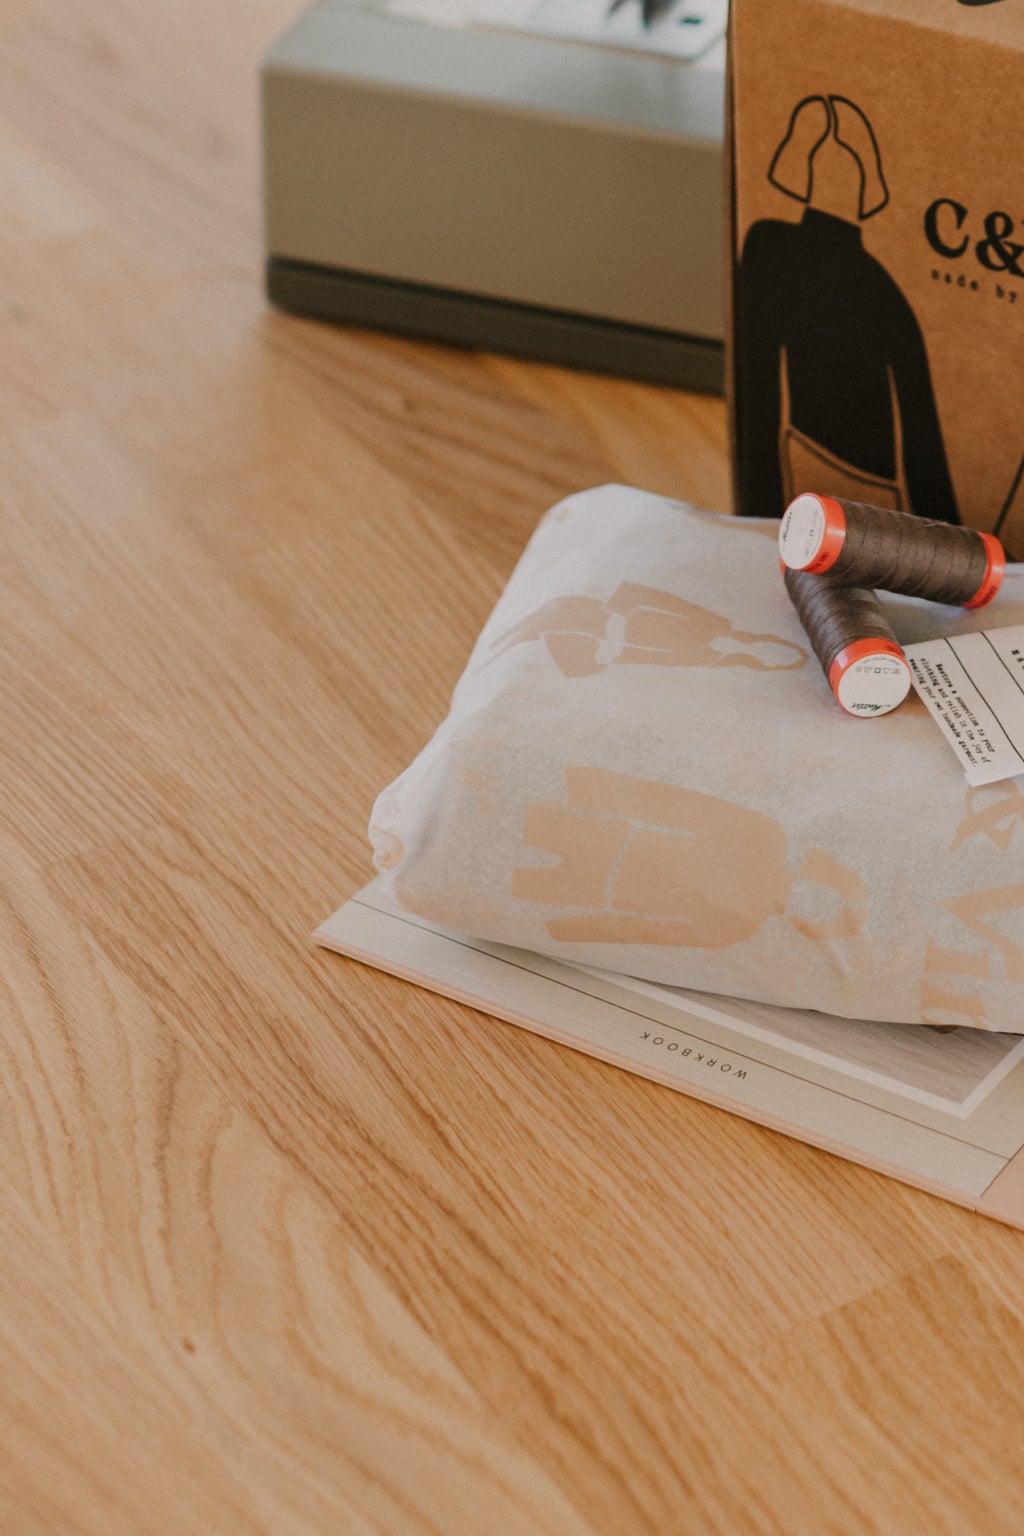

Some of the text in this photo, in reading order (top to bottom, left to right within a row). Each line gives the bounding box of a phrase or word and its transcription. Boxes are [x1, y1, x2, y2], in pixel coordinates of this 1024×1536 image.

[996, 284, 1018, 304] by
[923, 686, 936, 699] your
[965, 730, 975, 740] the
[972, 744, 984, 754] joy
[977, 729, 985, 737] to
[983, 738, 995, 753] your
[640, 1031, 748, 1080] WORKBOOK
